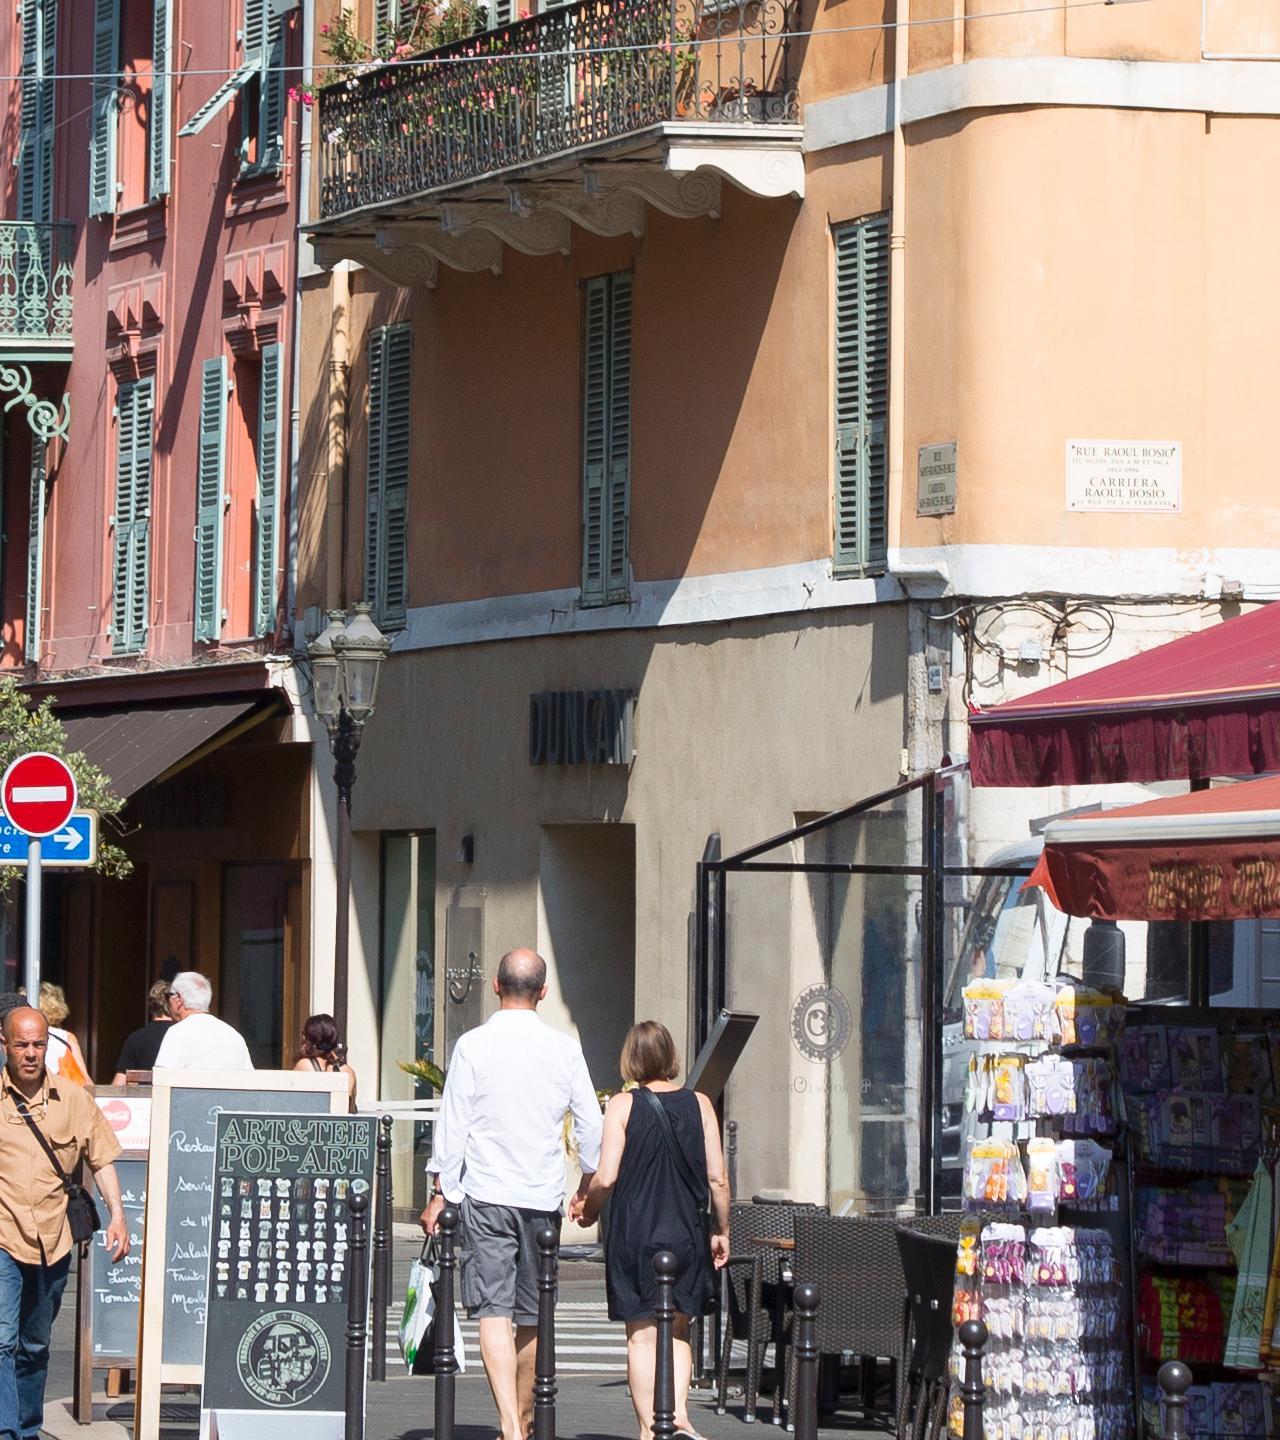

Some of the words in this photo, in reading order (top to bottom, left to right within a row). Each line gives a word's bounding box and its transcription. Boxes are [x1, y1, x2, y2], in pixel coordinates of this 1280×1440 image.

[1076, 446, 1098, 456] RUE
[1104, 446, 1140, 457] RAOUL
[1142, 447, 1174, 458] BOSIO
[1089, 477, 1159, 488] CARRIERA
[1085, 488, 1125, 498] RAOUL
[1129, 489, 1165, 498] BOSIO
[220, 1118, 370, 1146] ART&TEE
[219, 1144, 370, 1175] POP-ART
